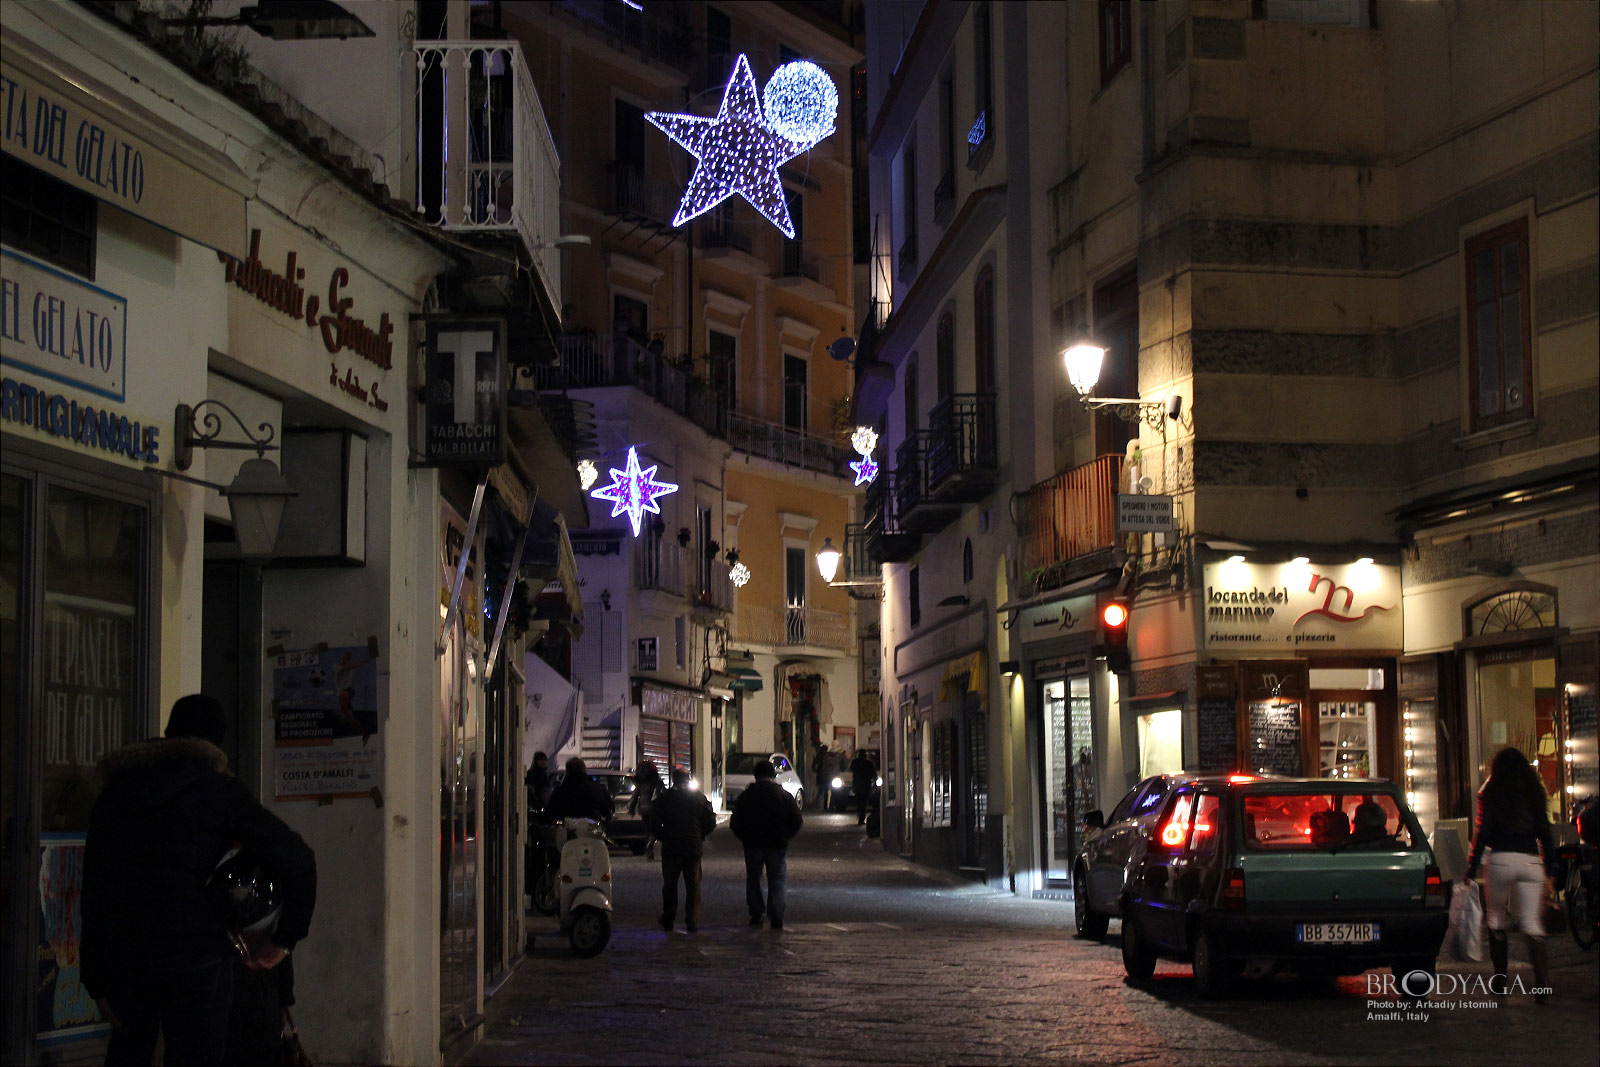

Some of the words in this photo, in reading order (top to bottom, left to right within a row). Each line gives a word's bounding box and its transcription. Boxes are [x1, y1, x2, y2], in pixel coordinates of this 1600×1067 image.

[33, 96, 67, 168] DEL
[76, 120, 144, 204] GELATO
[33, 291, 113, 373] GELATO
[437, 330, 494, 423] T
[432, 425, 497, 438] TABACCHI
[453, 440, 497, 455] BOLLATI
[1151, 502, 1169, 511] MOTORI
[1208, 586, 1266, 604] locanda
[1268, 587, 1289, 604] del
[1208, 604, 1275, 617] marinaio
[1295, 631, 1336, 644] pizzeria
[280, 711, 325, 720] CAMPIONATO
[280, 721, 317, 730] REGIONALE
[290, 727, 333, 737] PROMOZIONE
[283, 771, 311, 781] COSTA
[313, 769, 354, 780] D'AMALFI
[1305, 925, 1322, 940] BB
[1327, 925, 1371, 940] 357HR
